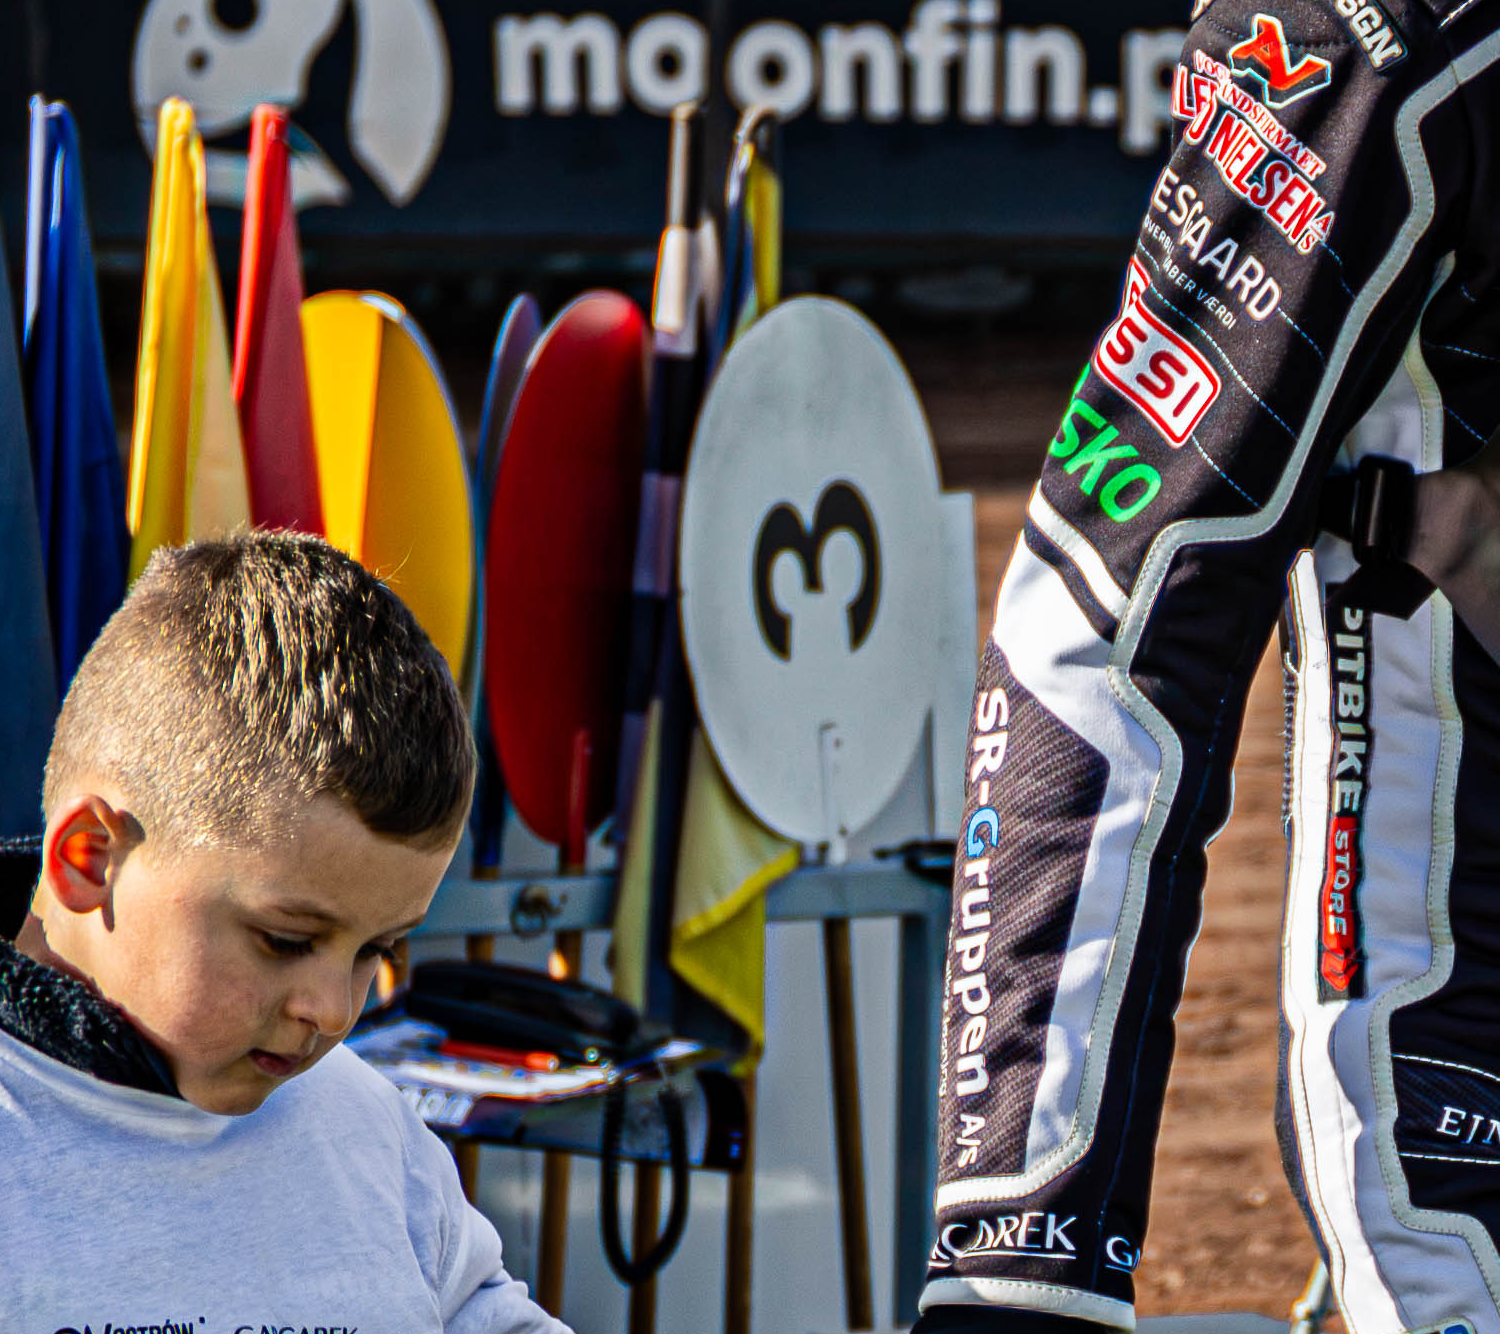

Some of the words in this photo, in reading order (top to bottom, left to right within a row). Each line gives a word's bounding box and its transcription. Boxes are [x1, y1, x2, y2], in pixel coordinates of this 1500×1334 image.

[1204, 109, 1327, 247] NIELSEN
[1048, 395, 1162, 524] SKO
[752, 478, 882, 663] 3
[949, 686, 1012, 1099] SR-Gruppen
[1328, 828, 1353, 936] STORE
[956, 1110, 985, 1169] A/S
